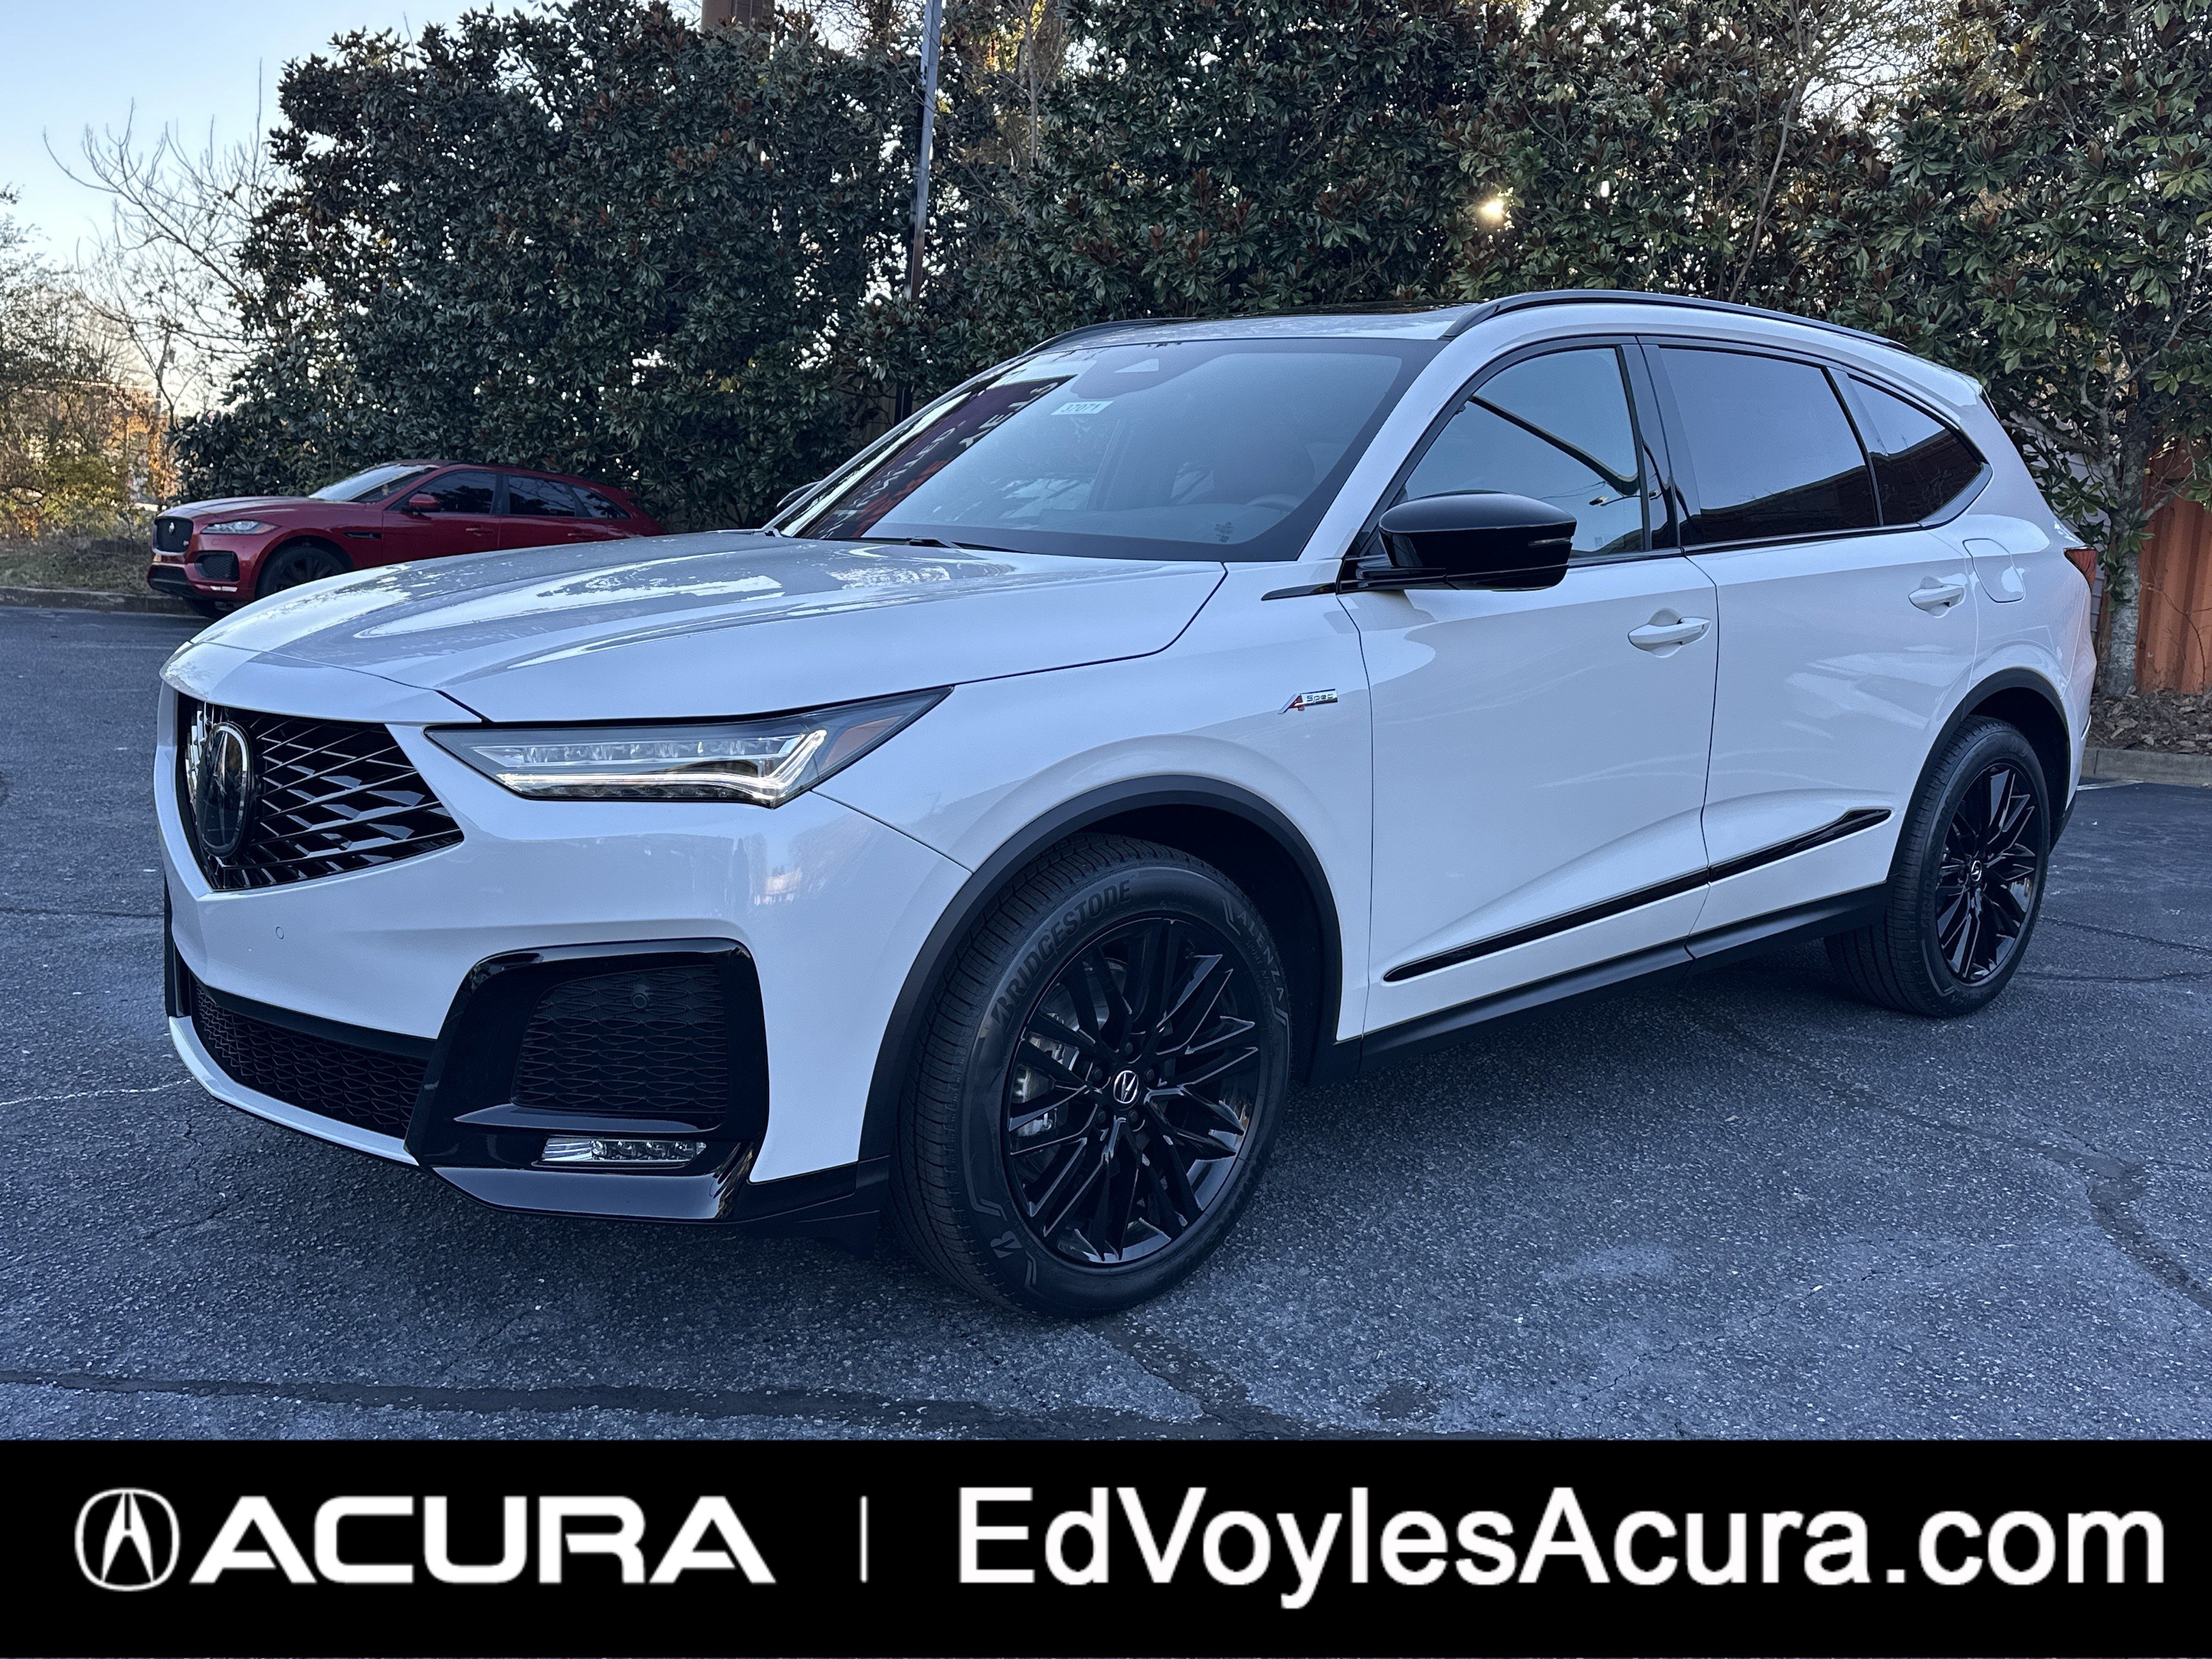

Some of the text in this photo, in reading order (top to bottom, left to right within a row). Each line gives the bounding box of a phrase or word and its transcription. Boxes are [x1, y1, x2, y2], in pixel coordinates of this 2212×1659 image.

[1060, 403, 1102, 413] 37071
[991, 879, 1132, 1029] BRIDGESTONE
[1237, 910, 1284, 1003] ALENZA
